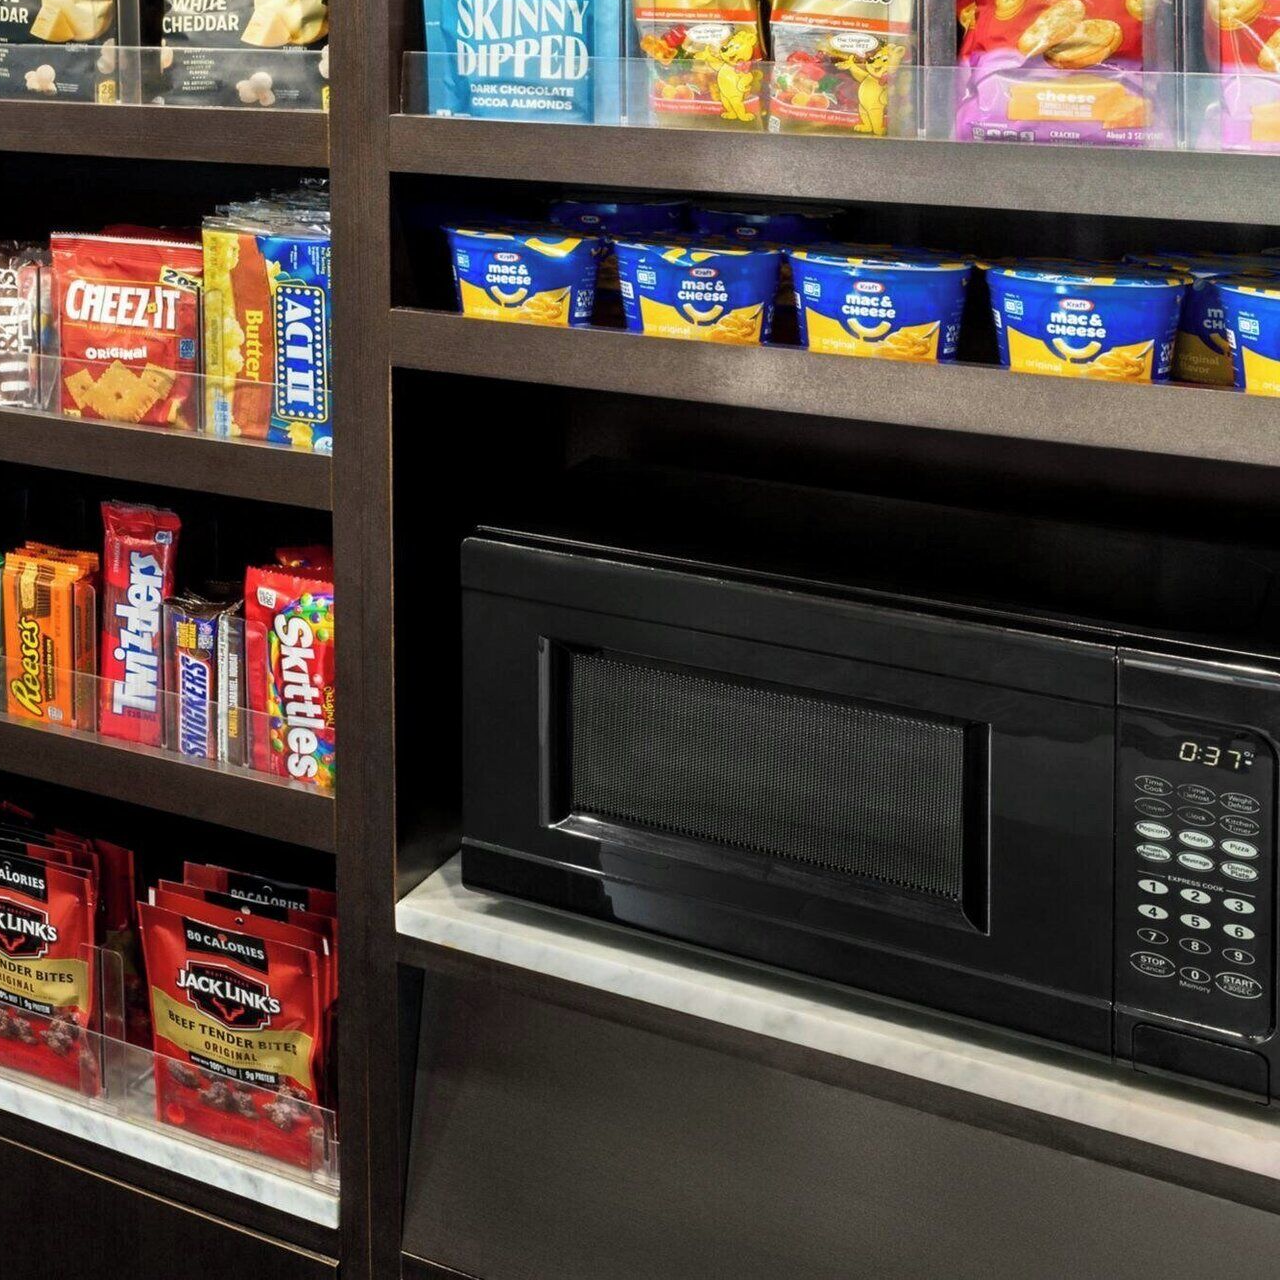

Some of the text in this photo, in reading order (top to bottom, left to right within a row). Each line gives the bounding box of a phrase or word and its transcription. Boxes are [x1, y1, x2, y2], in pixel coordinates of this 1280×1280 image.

[162, 14, 239, 33] CHEDDAR
[456, 35, 588, 80] DIPPED
[470, 83, 575, 97] DARK CHOCOLATE
[472, 97, 573, 111] COCOA ALMONDS
[1036, 92, 1096, 104] cheese
[681, 279, 712, 291] mac
[845, 294, 877, 308] mac
[1050, 312, 1102, 327] mac &
[245, 309, 264, 383] Butter
[284, 297, 315, 406] ACT II
[113, 551, 164, 714] Twizzlers
[275, 614, 325, 778] Skittles
[181, 656, 210, 758] SNICKERS
[1150, 882, 1156, 892] 1
[1168, 875, 1224, 892] EXPRESS COOK
[1191, 891, 1199, 901] 2
[1149, 908, 1157, 917] 4
[1235, 901, 1243, 911] 3
[7, 915, 58, 943] LINK'S
[1191, 917, 1199, 927] 5
[1149, 931, 1157, 941] 7
[1234, 927, 1243, 937] 6
[186, 929, 265, 960] 80 CALORIES
[1191, 942, 1199, 950] 8
[1140, 955, 1165, 965] STOP
[1234, 952, 1243, 961] 9
[35, 970, 74, 984] BITES
[1223, 976, 1254, 988] START
[176, 968, 281, 1014] JACK LINK'S
[1180, 981, 1211, 994] Memory
[168, 1009, 196, 1031] BEEF
[198, 1022, 254, 1050] TENDER
[204, 1041, 258, 1062] ORIGINAL
